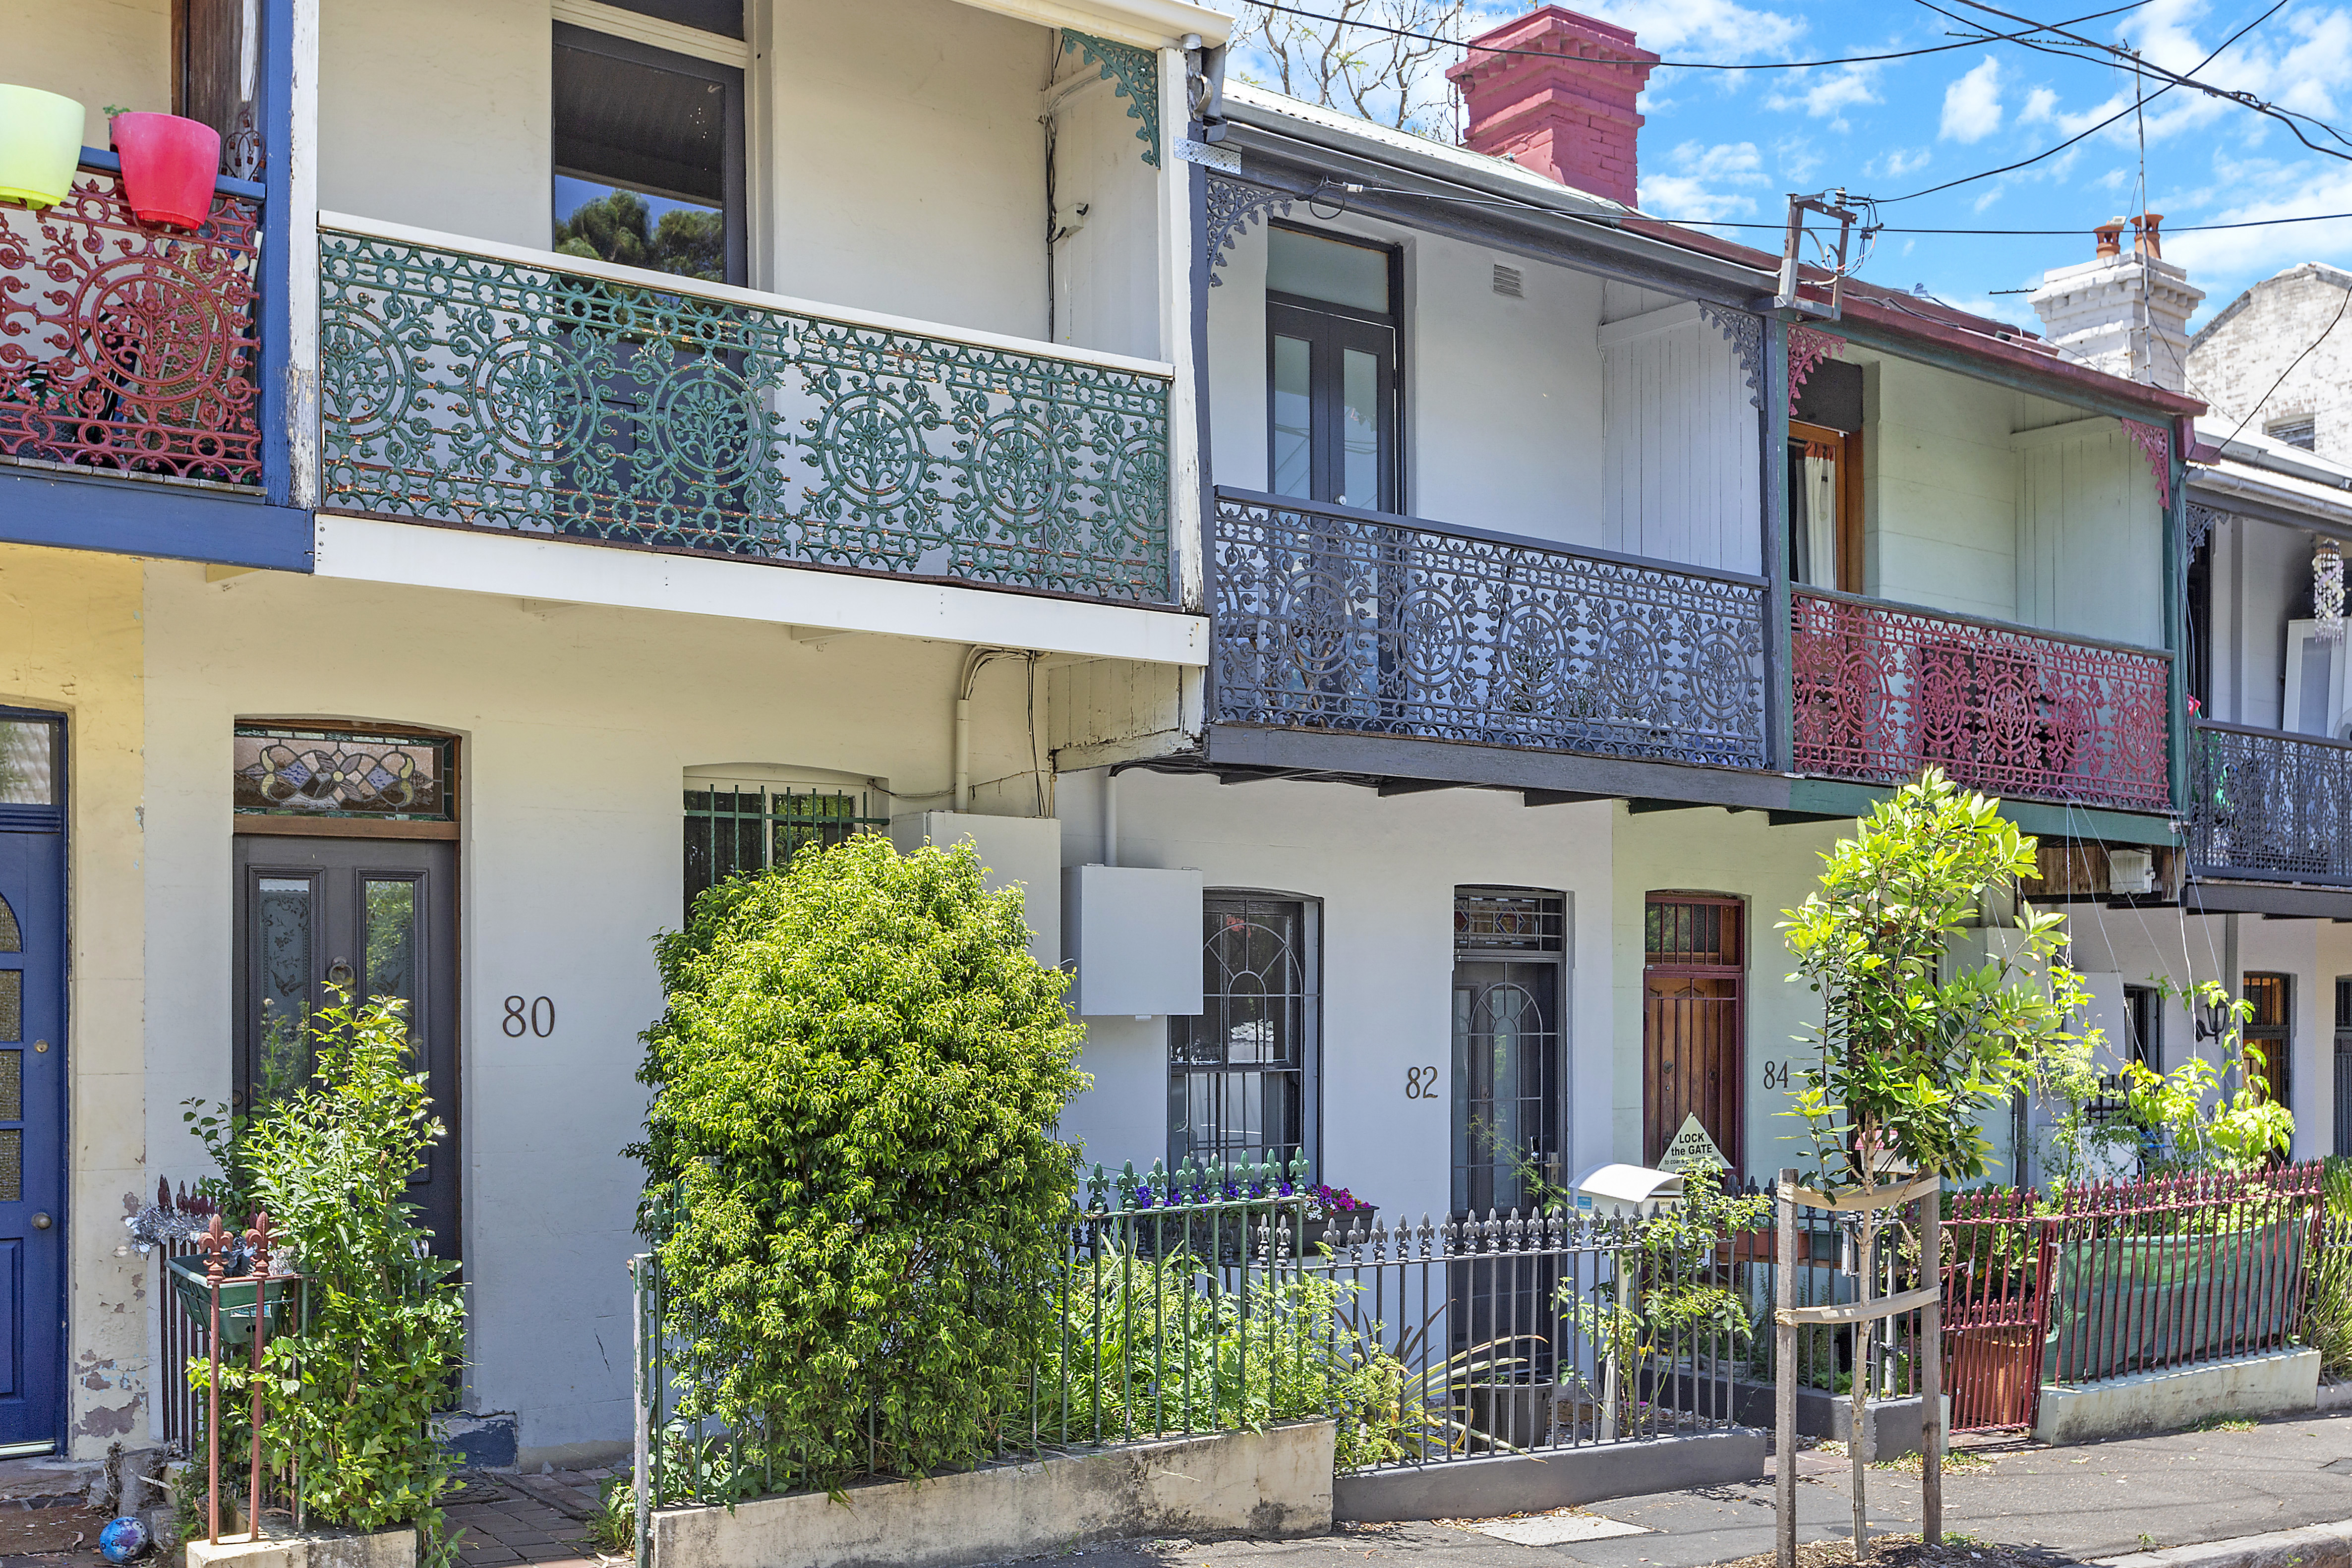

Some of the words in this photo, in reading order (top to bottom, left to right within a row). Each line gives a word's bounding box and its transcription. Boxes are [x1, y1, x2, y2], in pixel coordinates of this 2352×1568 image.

[503, 995, 555, 1038] 80
[1406, 1066, 1438, 1099] 82
[1764, 1060, 1788, 1090] 84
[1671, 1146, 1686, 1156] the
[1688, 1144, 1712, 1155] GATE
[1679, 1133, 1705, 1144] LOCK
